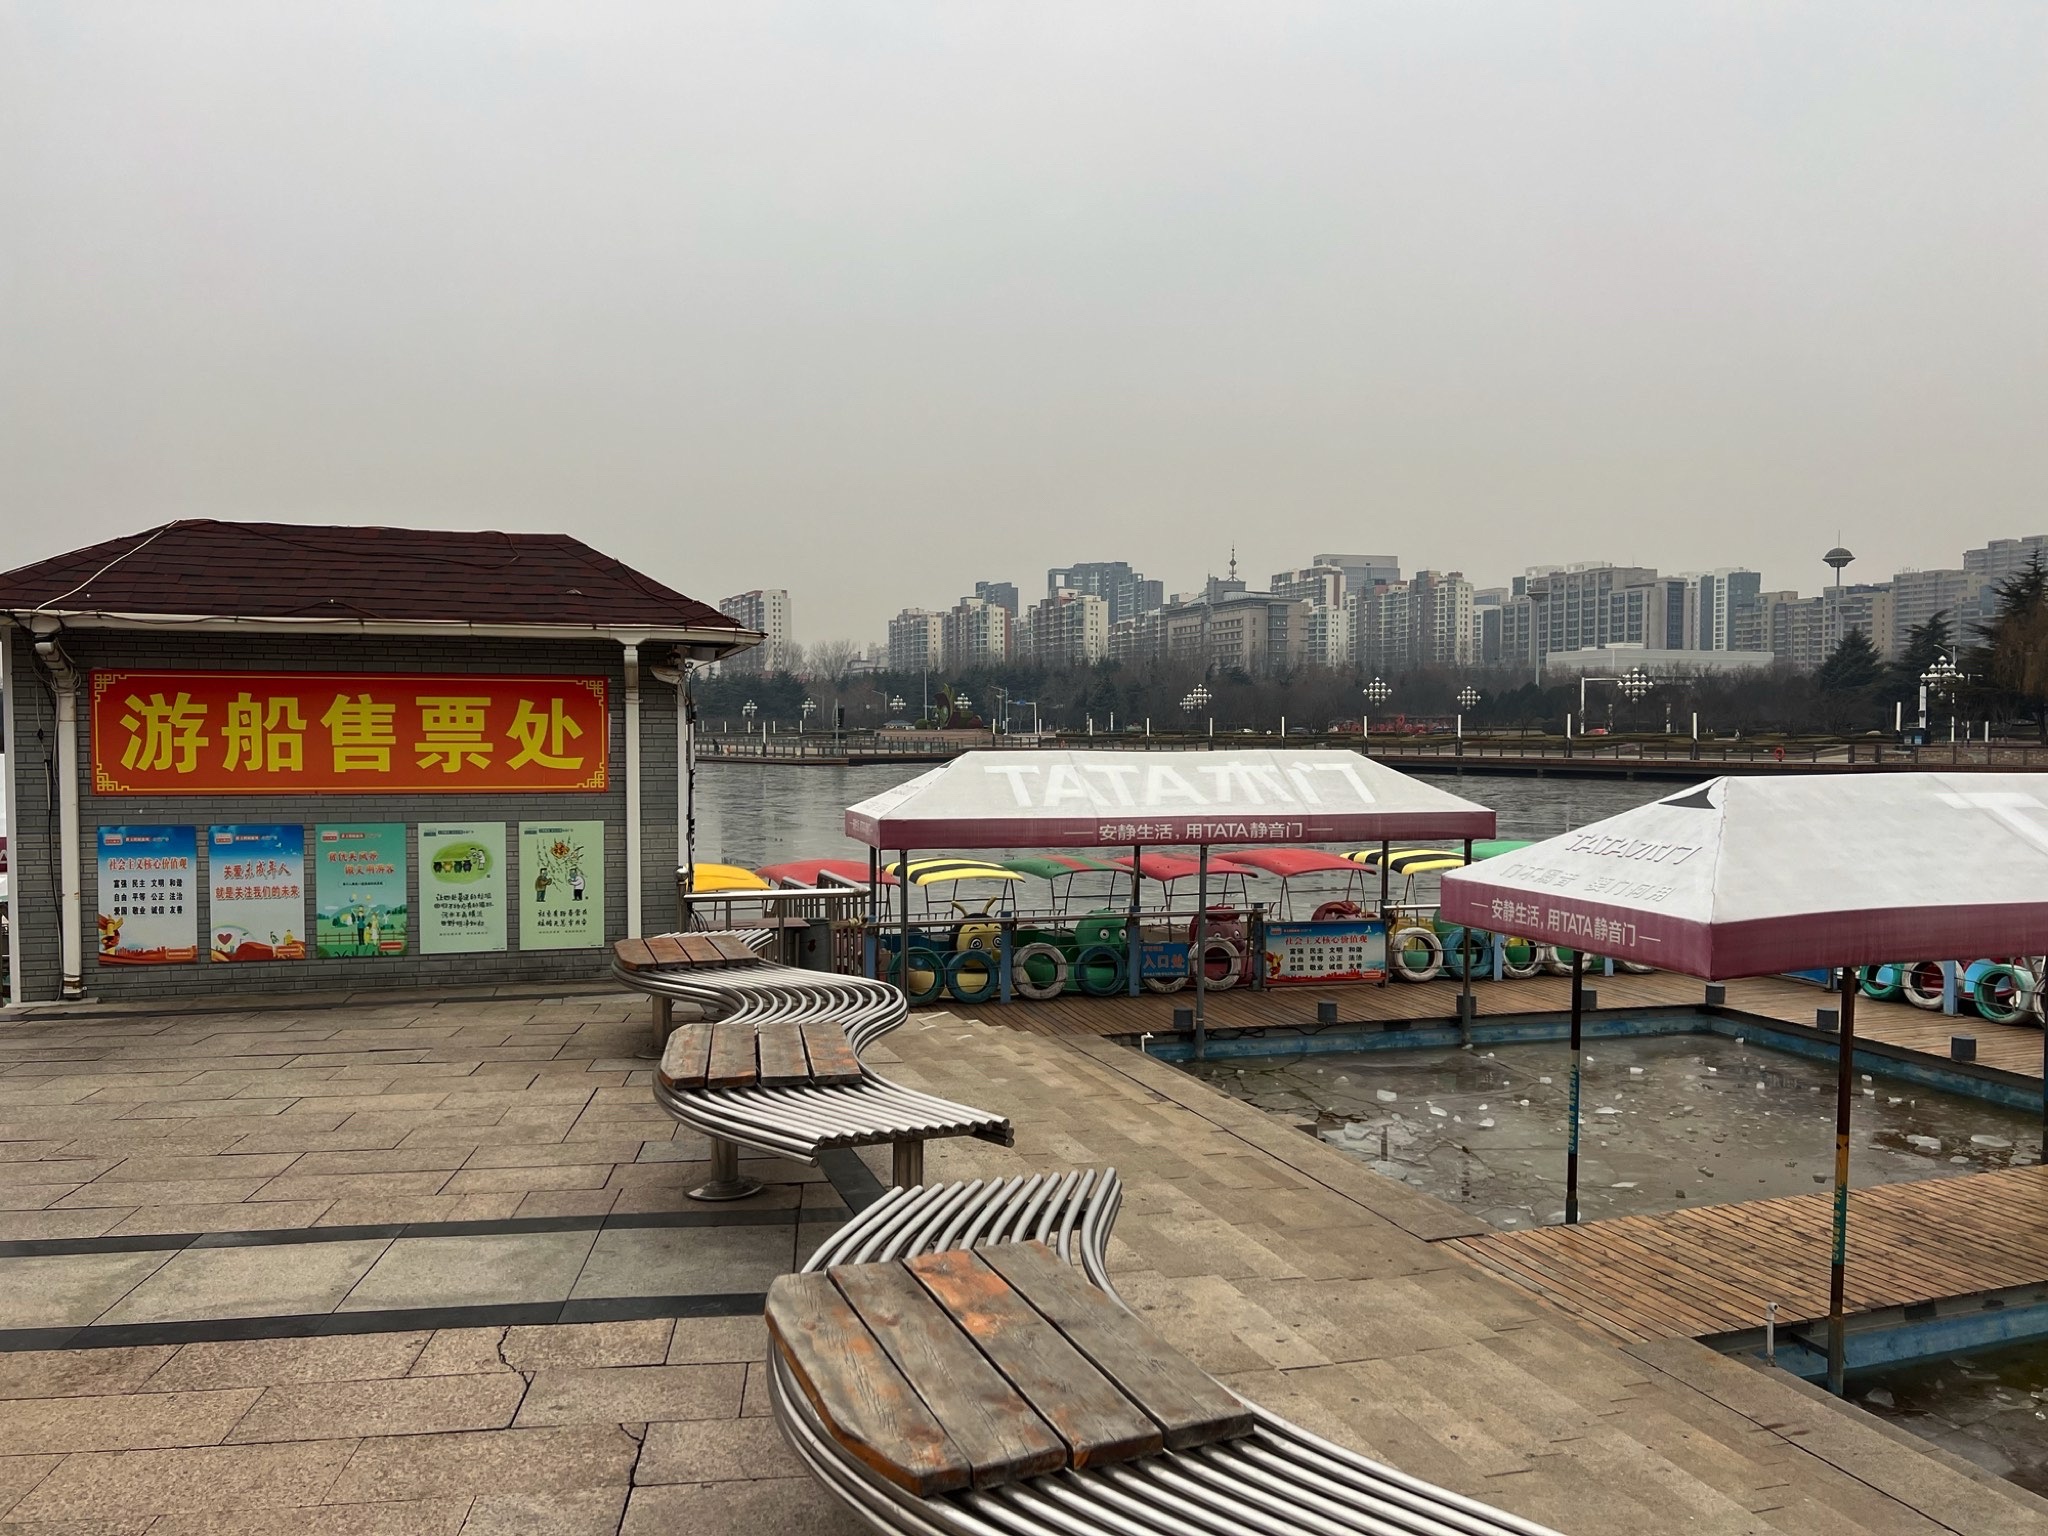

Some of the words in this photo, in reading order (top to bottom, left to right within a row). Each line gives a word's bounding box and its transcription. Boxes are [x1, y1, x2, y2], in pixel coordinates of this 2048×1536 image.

[119, 691, 584, 774] 游船售票处
[109, 858, 187, 870] 社会主义核心价值观
[113, 879, 127, 888] 富强
[132, 879, 146, 888] 民主
[151, 879, 165, 887] 文明
[169, 878, 183, 887] 和谐
[113, 893, 127, 902] 自由
[132, 893, 146, 901] 平等
[151, 892, 165, 901] 公正
[169, 892, 183, 900] 法治
[215, 885, 300, 900] 就是关注我们的未来
[113, 906, 127, 915] 爱国
[132, 906, 146, 914] 敬业
[151, 906, 165, 914] 诚信
[169, 905, 183, 914] 友善
[1285, 935, 1368, 945] 社会主义核心价值观
